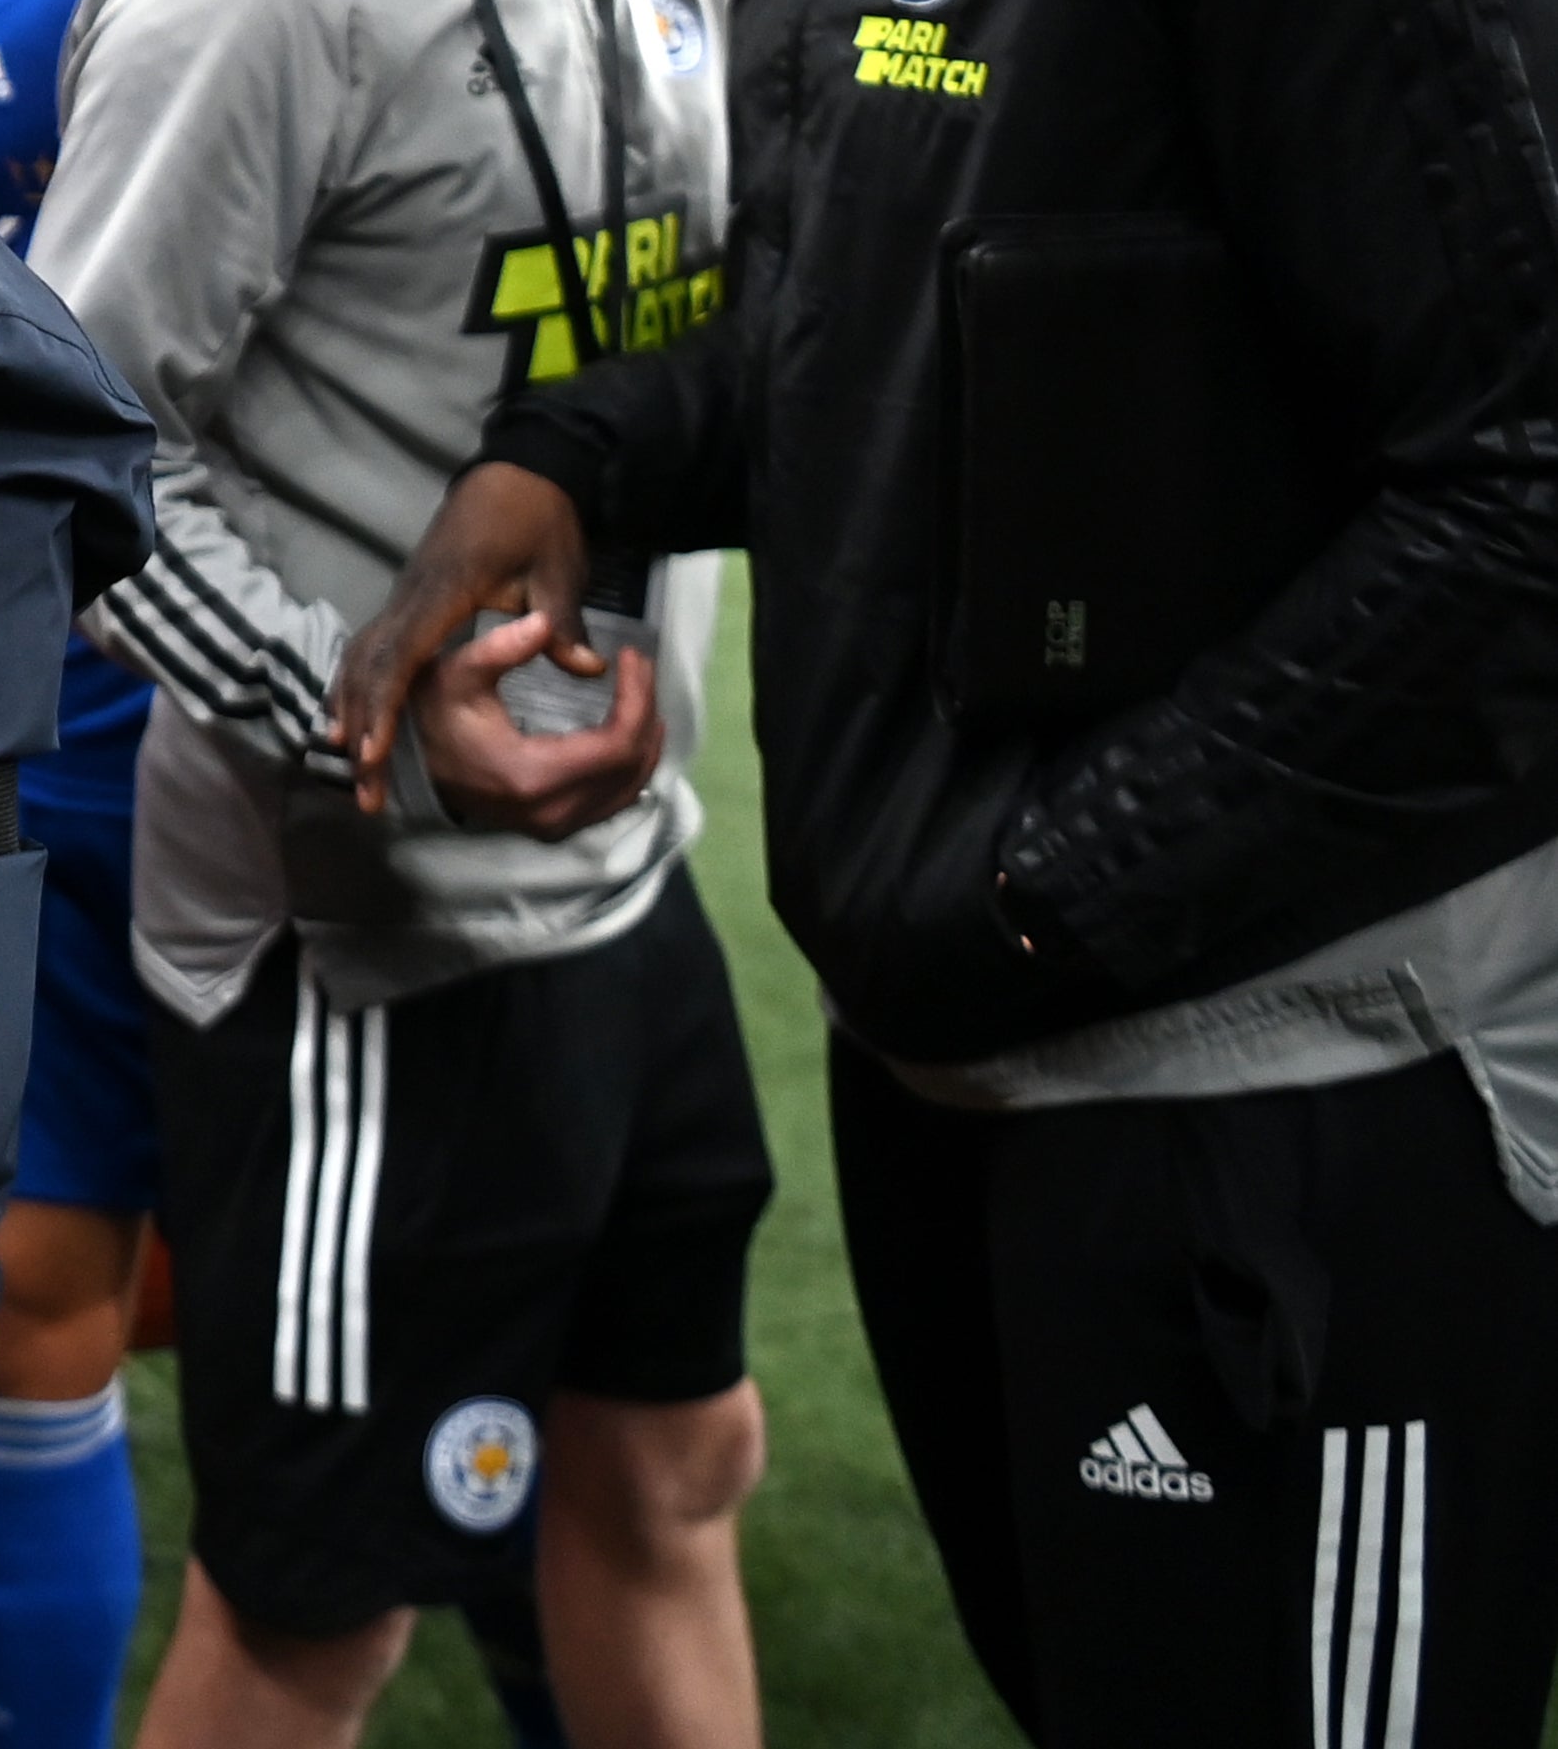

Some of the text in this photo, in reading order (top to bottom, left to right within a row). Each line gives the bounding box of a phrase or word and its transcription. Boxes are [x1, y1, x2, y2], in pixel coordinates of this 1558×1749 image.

[853, 15, 947, 57] PARI
[855, 49, 989, 99] MATCH
[1079, 1455, 1215, 1503] adidas
